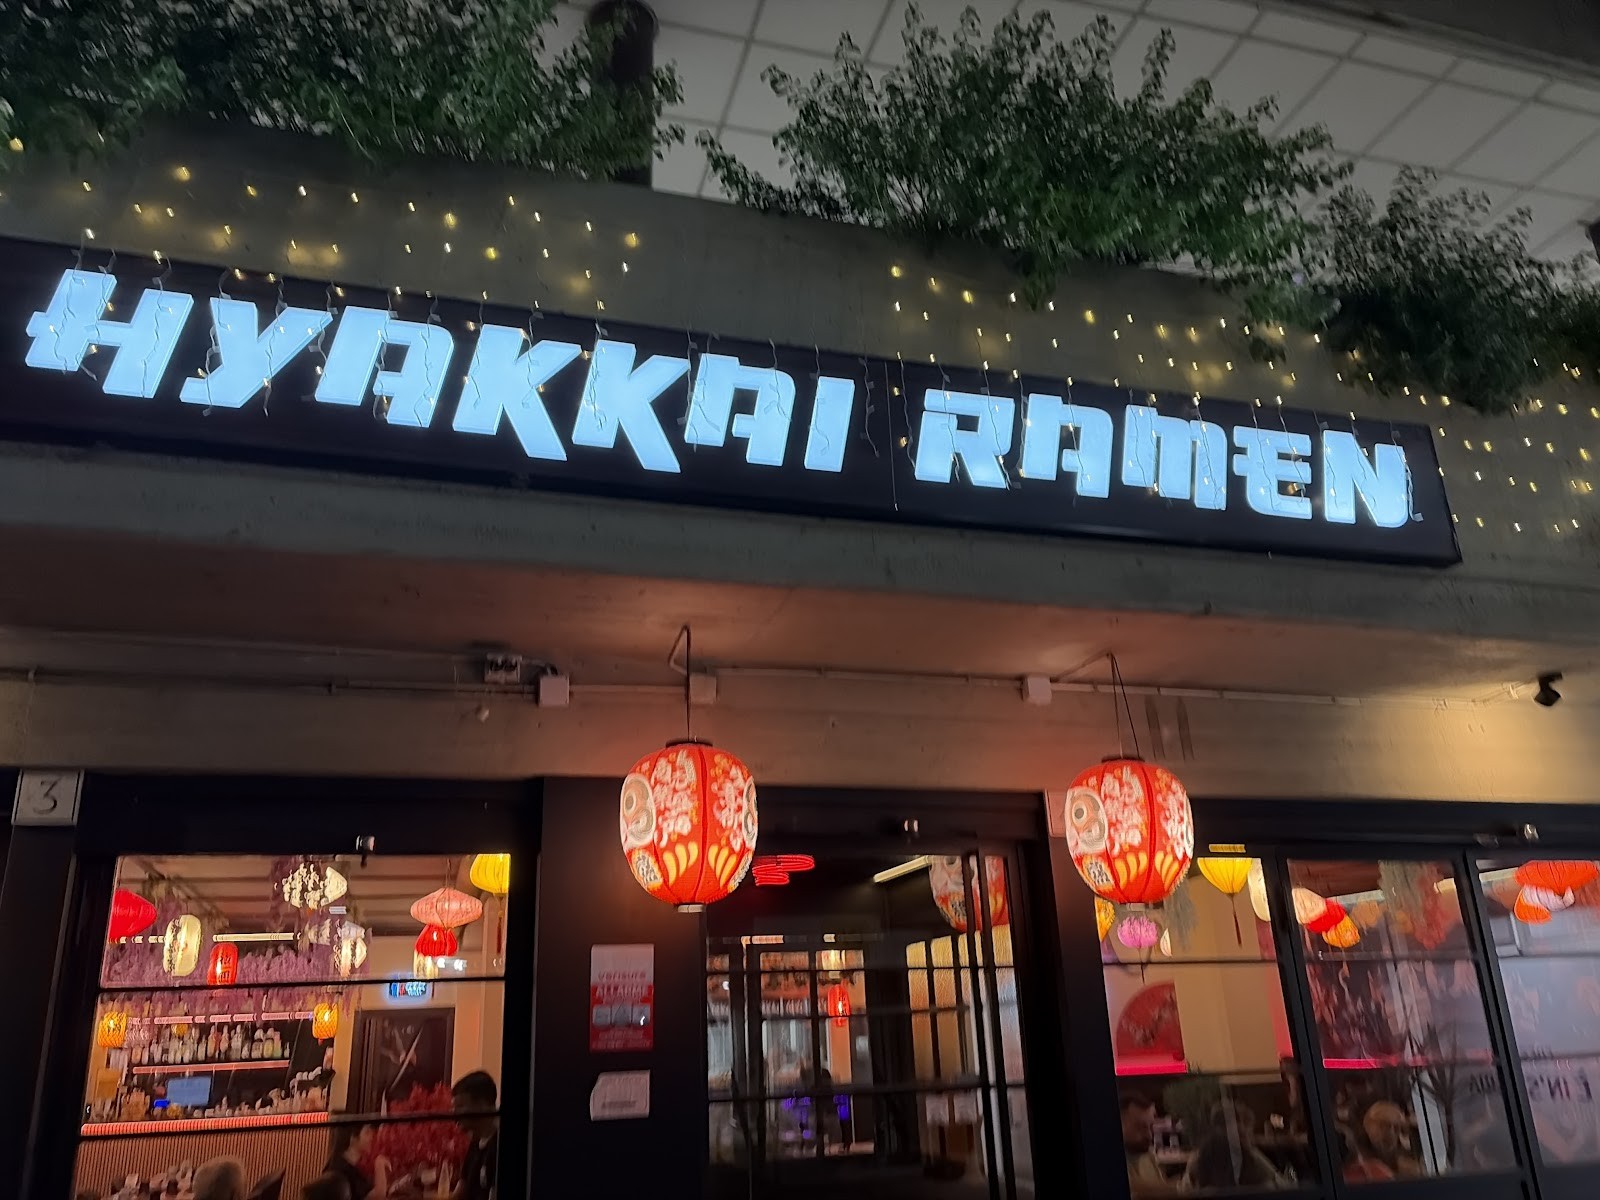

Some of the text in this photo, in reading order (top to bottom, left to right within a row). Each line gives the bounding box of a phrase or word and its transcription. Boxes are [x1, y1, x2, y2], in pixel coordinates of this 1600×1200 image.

[25, 269, 1409, 528] HYAKKAI RAMEN
[33, 778, 63, 815] 3
